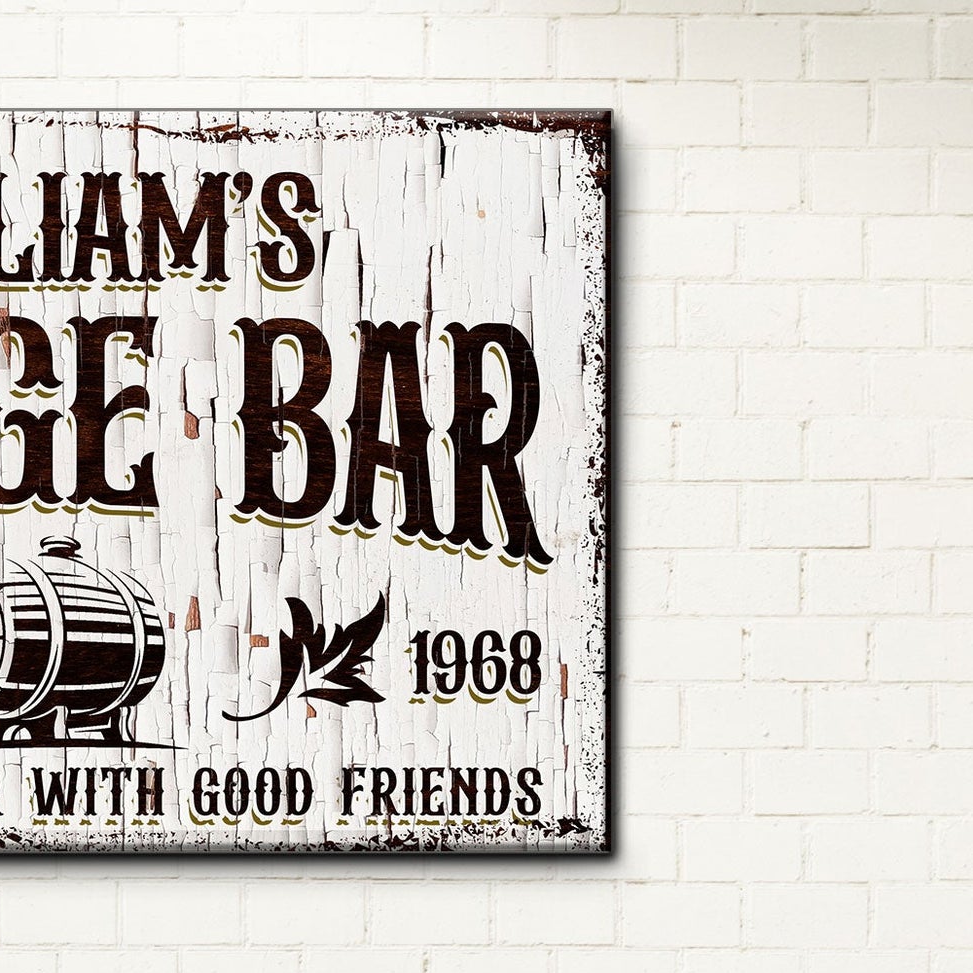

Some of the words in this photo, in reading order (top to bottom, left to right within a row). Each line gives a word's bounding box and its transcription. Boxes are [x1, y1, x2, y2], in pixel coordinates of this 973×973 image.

[233, 316, 554, 567] BAR
[409, 629, 543, 698] 1968
[32, 766, 165, 821] WITH
[192, 766, 314, 821] GOOD
[341, 766, 544, 821] FRIENDS
